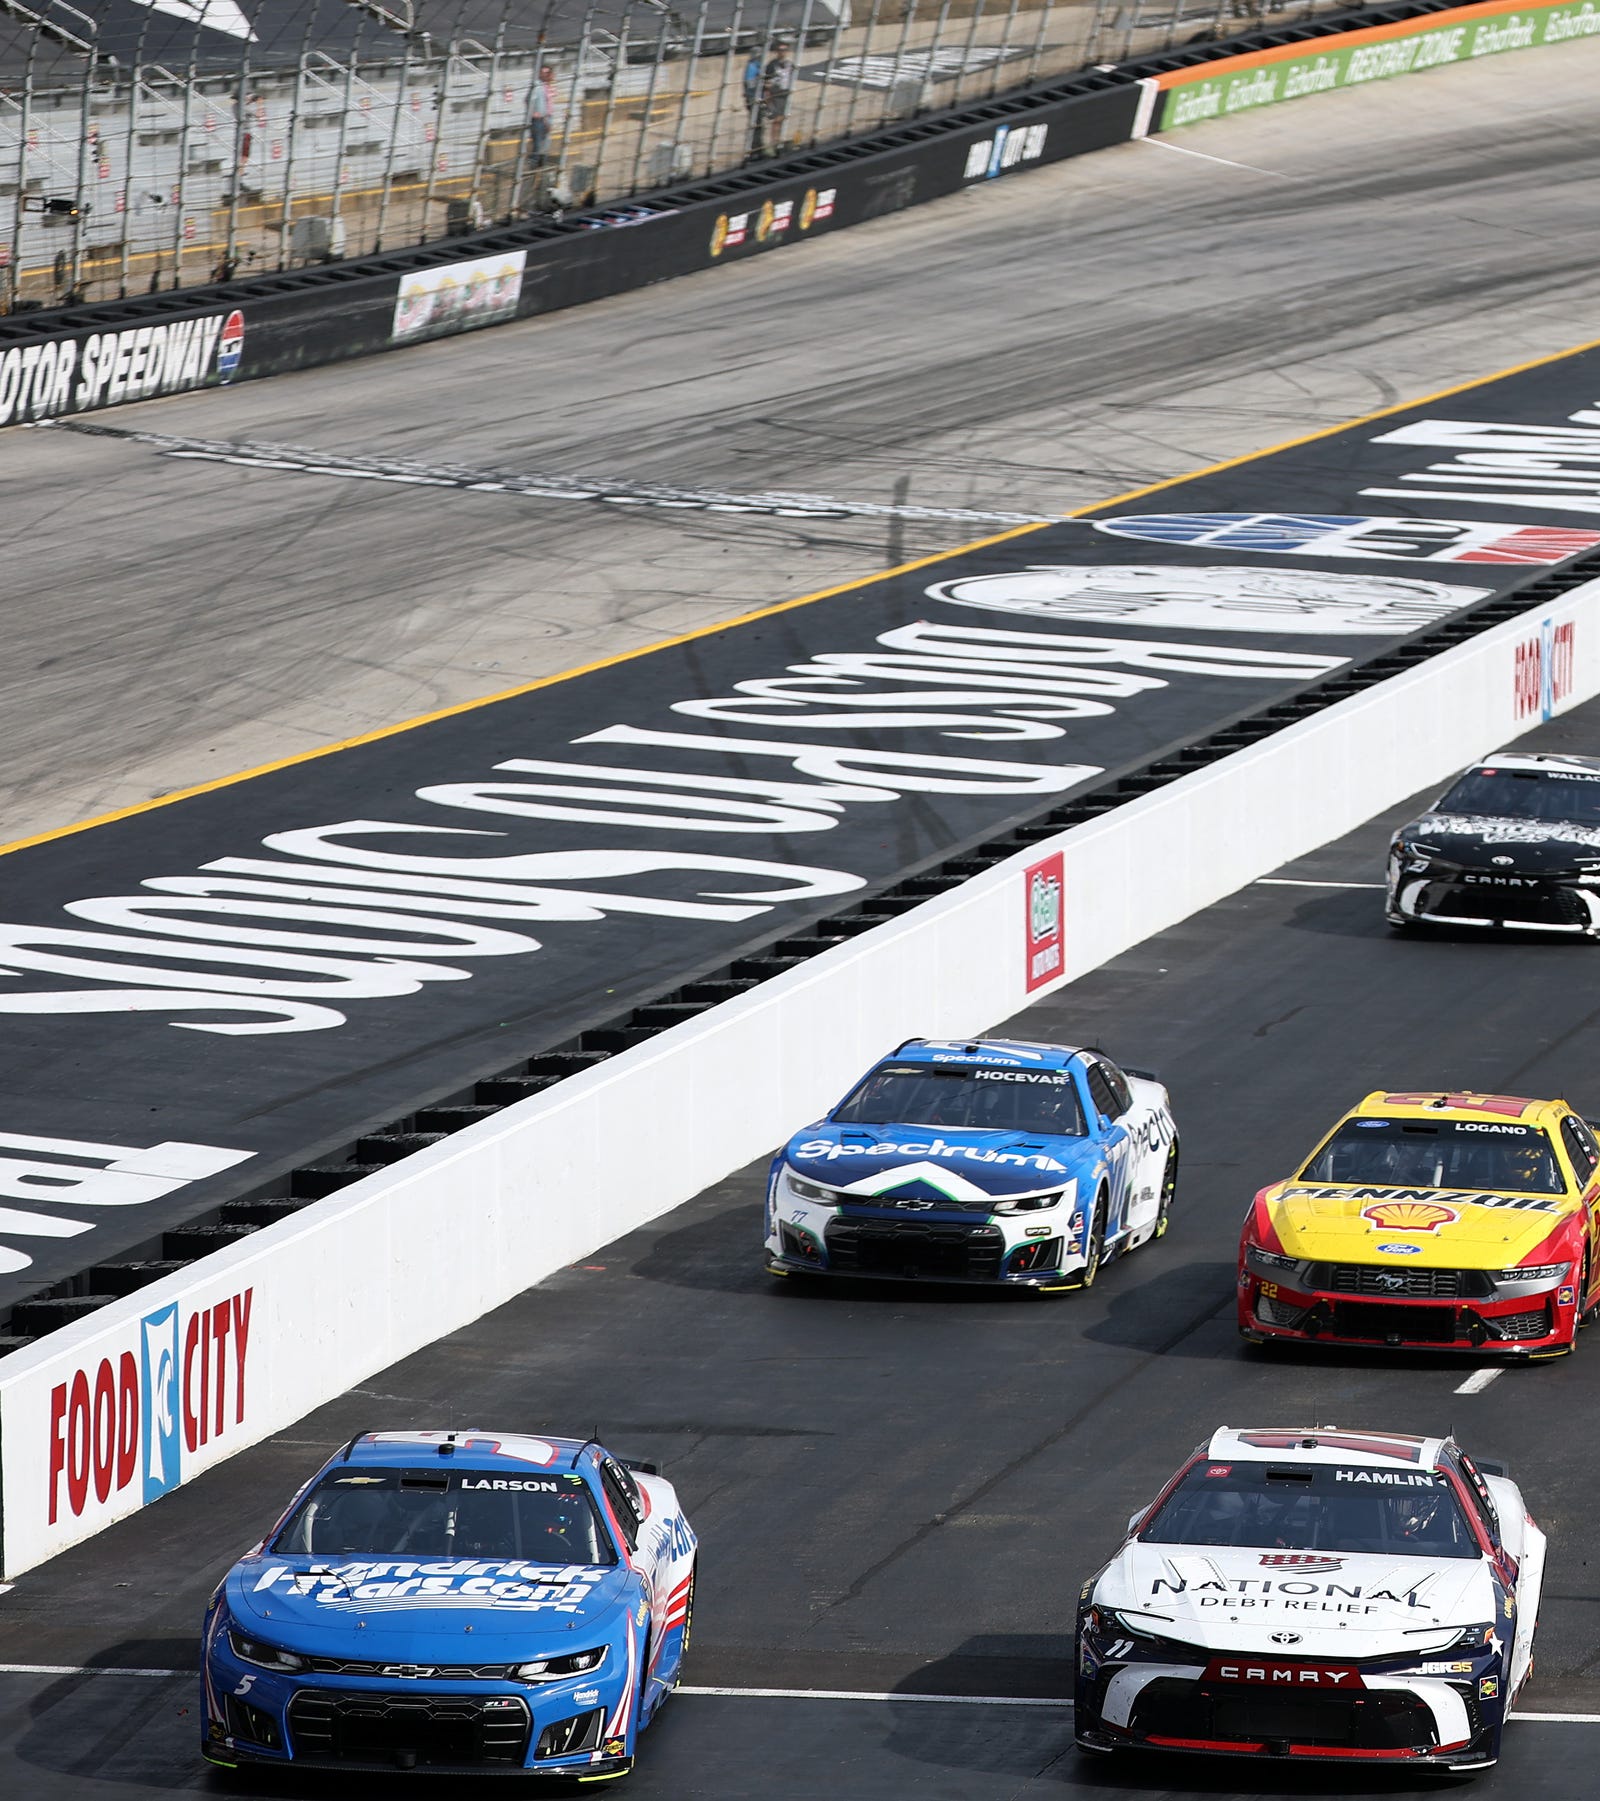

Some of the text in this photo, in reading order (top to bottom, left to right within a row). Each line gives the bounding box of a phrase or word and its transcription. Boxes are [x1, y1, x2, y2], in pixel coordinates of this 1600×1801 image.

[1344, 27, 1466, 84] RESTART ZONE
[0, 314, 224, 427] OTOR SPEEDWAY
[1513, 621, 1577, 721] FOOD CITY
[690, 620, 1354, 743] Bass
[412, 724, 1106, 833] Pro
[1464, 875, 1539, 888] CAMRY
[931, 1053, 1022, 1066] Spectrum
[974, 1069, 1069, 1086] HOCEVAR
[1454, 1122, 1527, 1136] LOGANO
[795, 1138, 1067, 1174] Spectrum
[1275, 1187, 1561, 1214] PENNZOIL
[791, 1210, 807, 1222] 77
[1261, 1280, 1278, 1299] 22
[48, 1286, 254, 1526] FOOD CITY
[461, 1478, 558, 1493] LARSON
[1335, 1470, 1434, 1487] HAMLIN
[253, 1560, 611, 1595] Hendrick
[1151, 1578, 1431, 1609] NATIONAL
[1200, 1597, 1378, 1615] DEBT RELIEF
[1105, 1639, 1136, 1659] 11
[235, 1675, 256, 1695] 5
[1220, 1666, 1349, 1684] CAMRY
[573, 1689, 599, 1701] Hendrick
